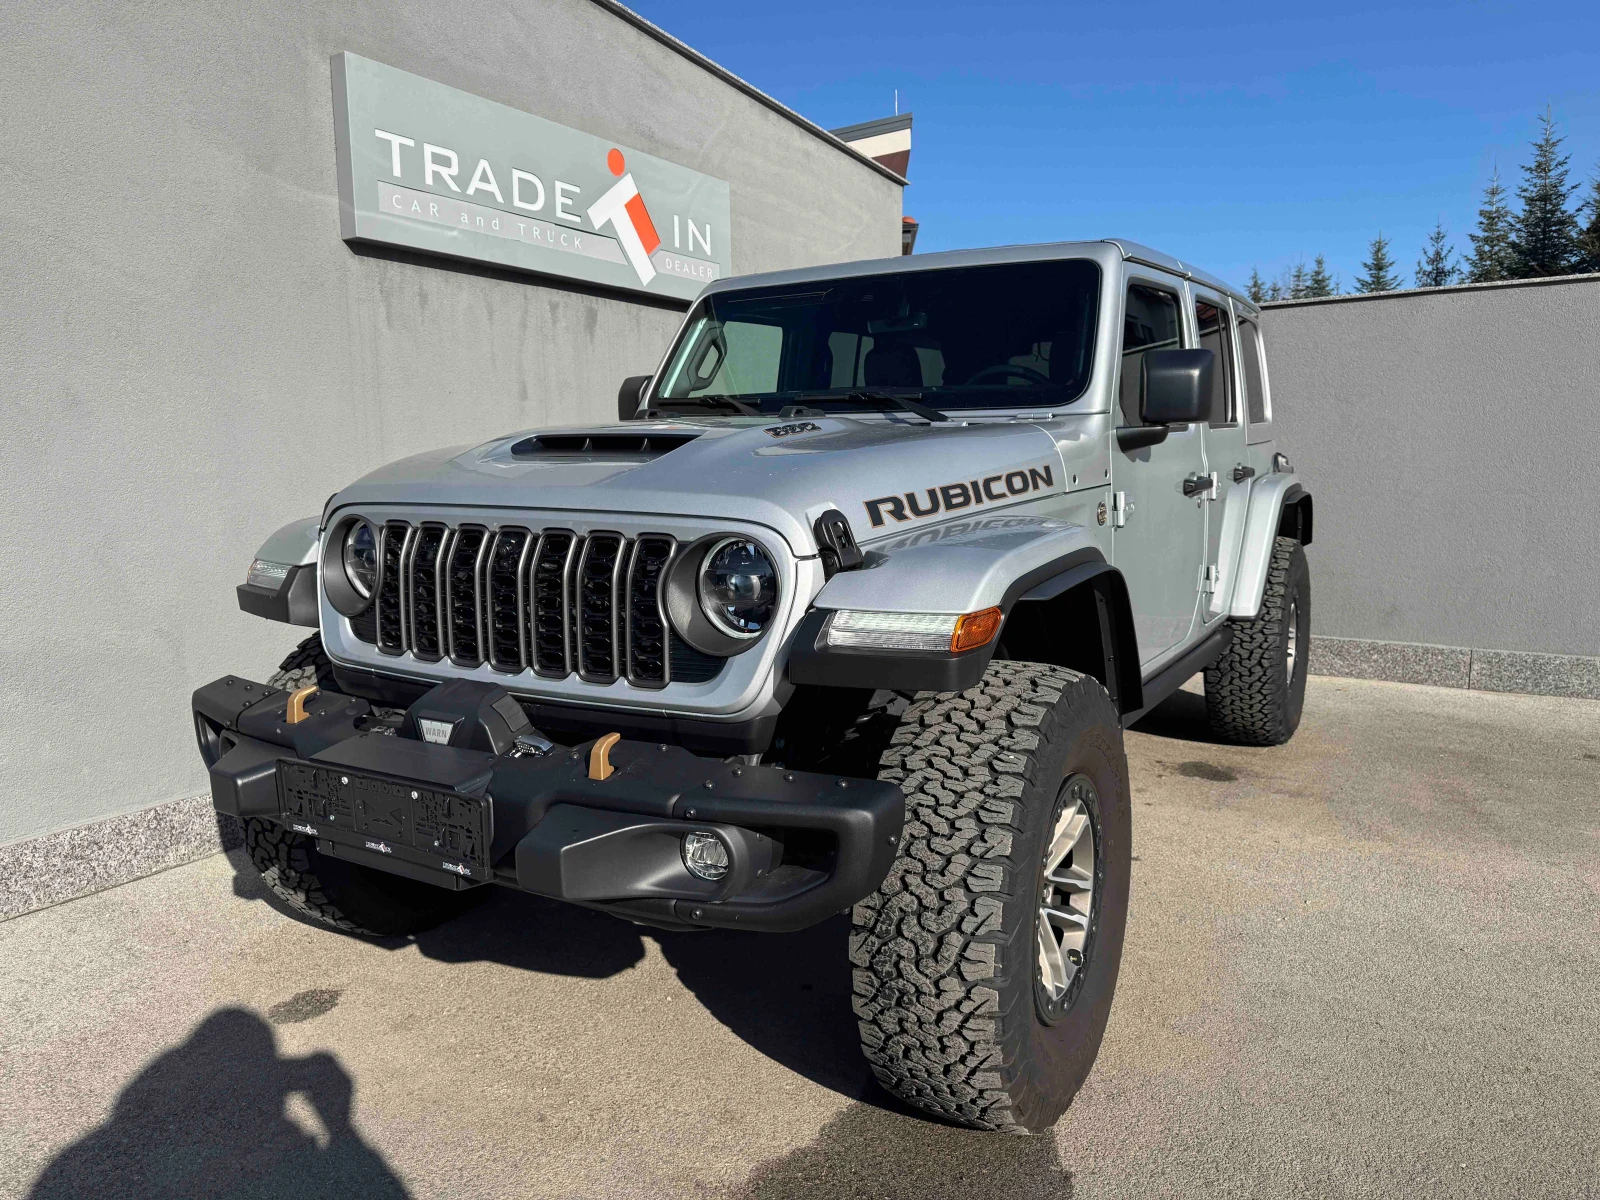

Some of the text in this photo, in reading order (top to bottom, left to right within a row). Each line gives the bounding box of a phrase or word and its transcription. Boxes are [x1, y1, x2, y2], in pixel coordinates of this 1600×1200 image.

[374, 128, 582, 223] TRADE
[672, 214, 712, 257] IN
[391, 194, 714, 280] CAR and TRUCK DEALER
[862, 464, 1055, 529] RUBICON
[425, 726, 447, 739] WARN
